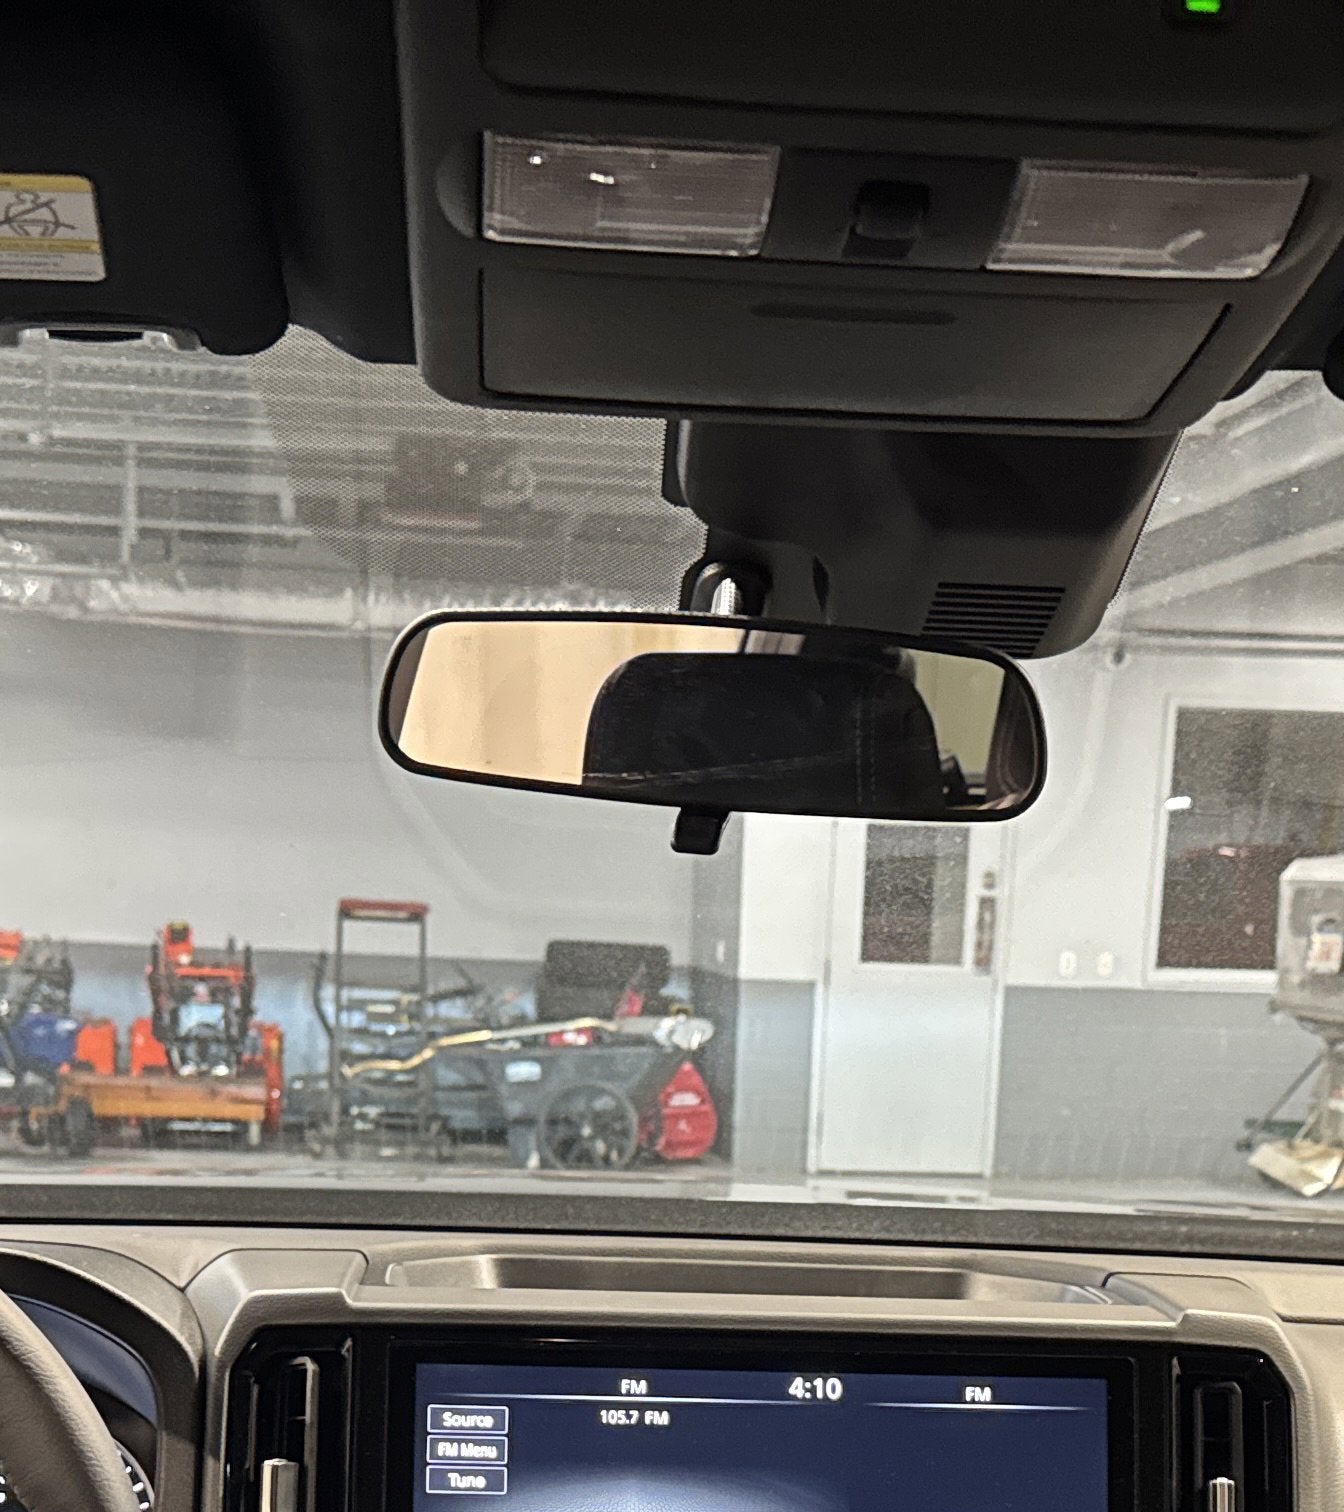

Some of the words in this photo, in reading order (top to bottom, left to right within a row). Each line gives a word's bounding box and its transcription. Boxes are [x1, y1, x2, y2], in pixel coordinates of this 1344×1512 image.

[621, 1379, 648, 1395] FM
[789, 1376, 844, 1401] 4:10
[965, 1386, 992, 1402] FM
[442, 1411, 495, 1429] Source
[600, 1409, 639, 1425] 105.7
[645, 1410, 671, 1426] FM
[437, 1441, 458, 1457] FM
[460, 1442, 498, 1459] Menu
[447, 1472, 487, 1489] Tune
